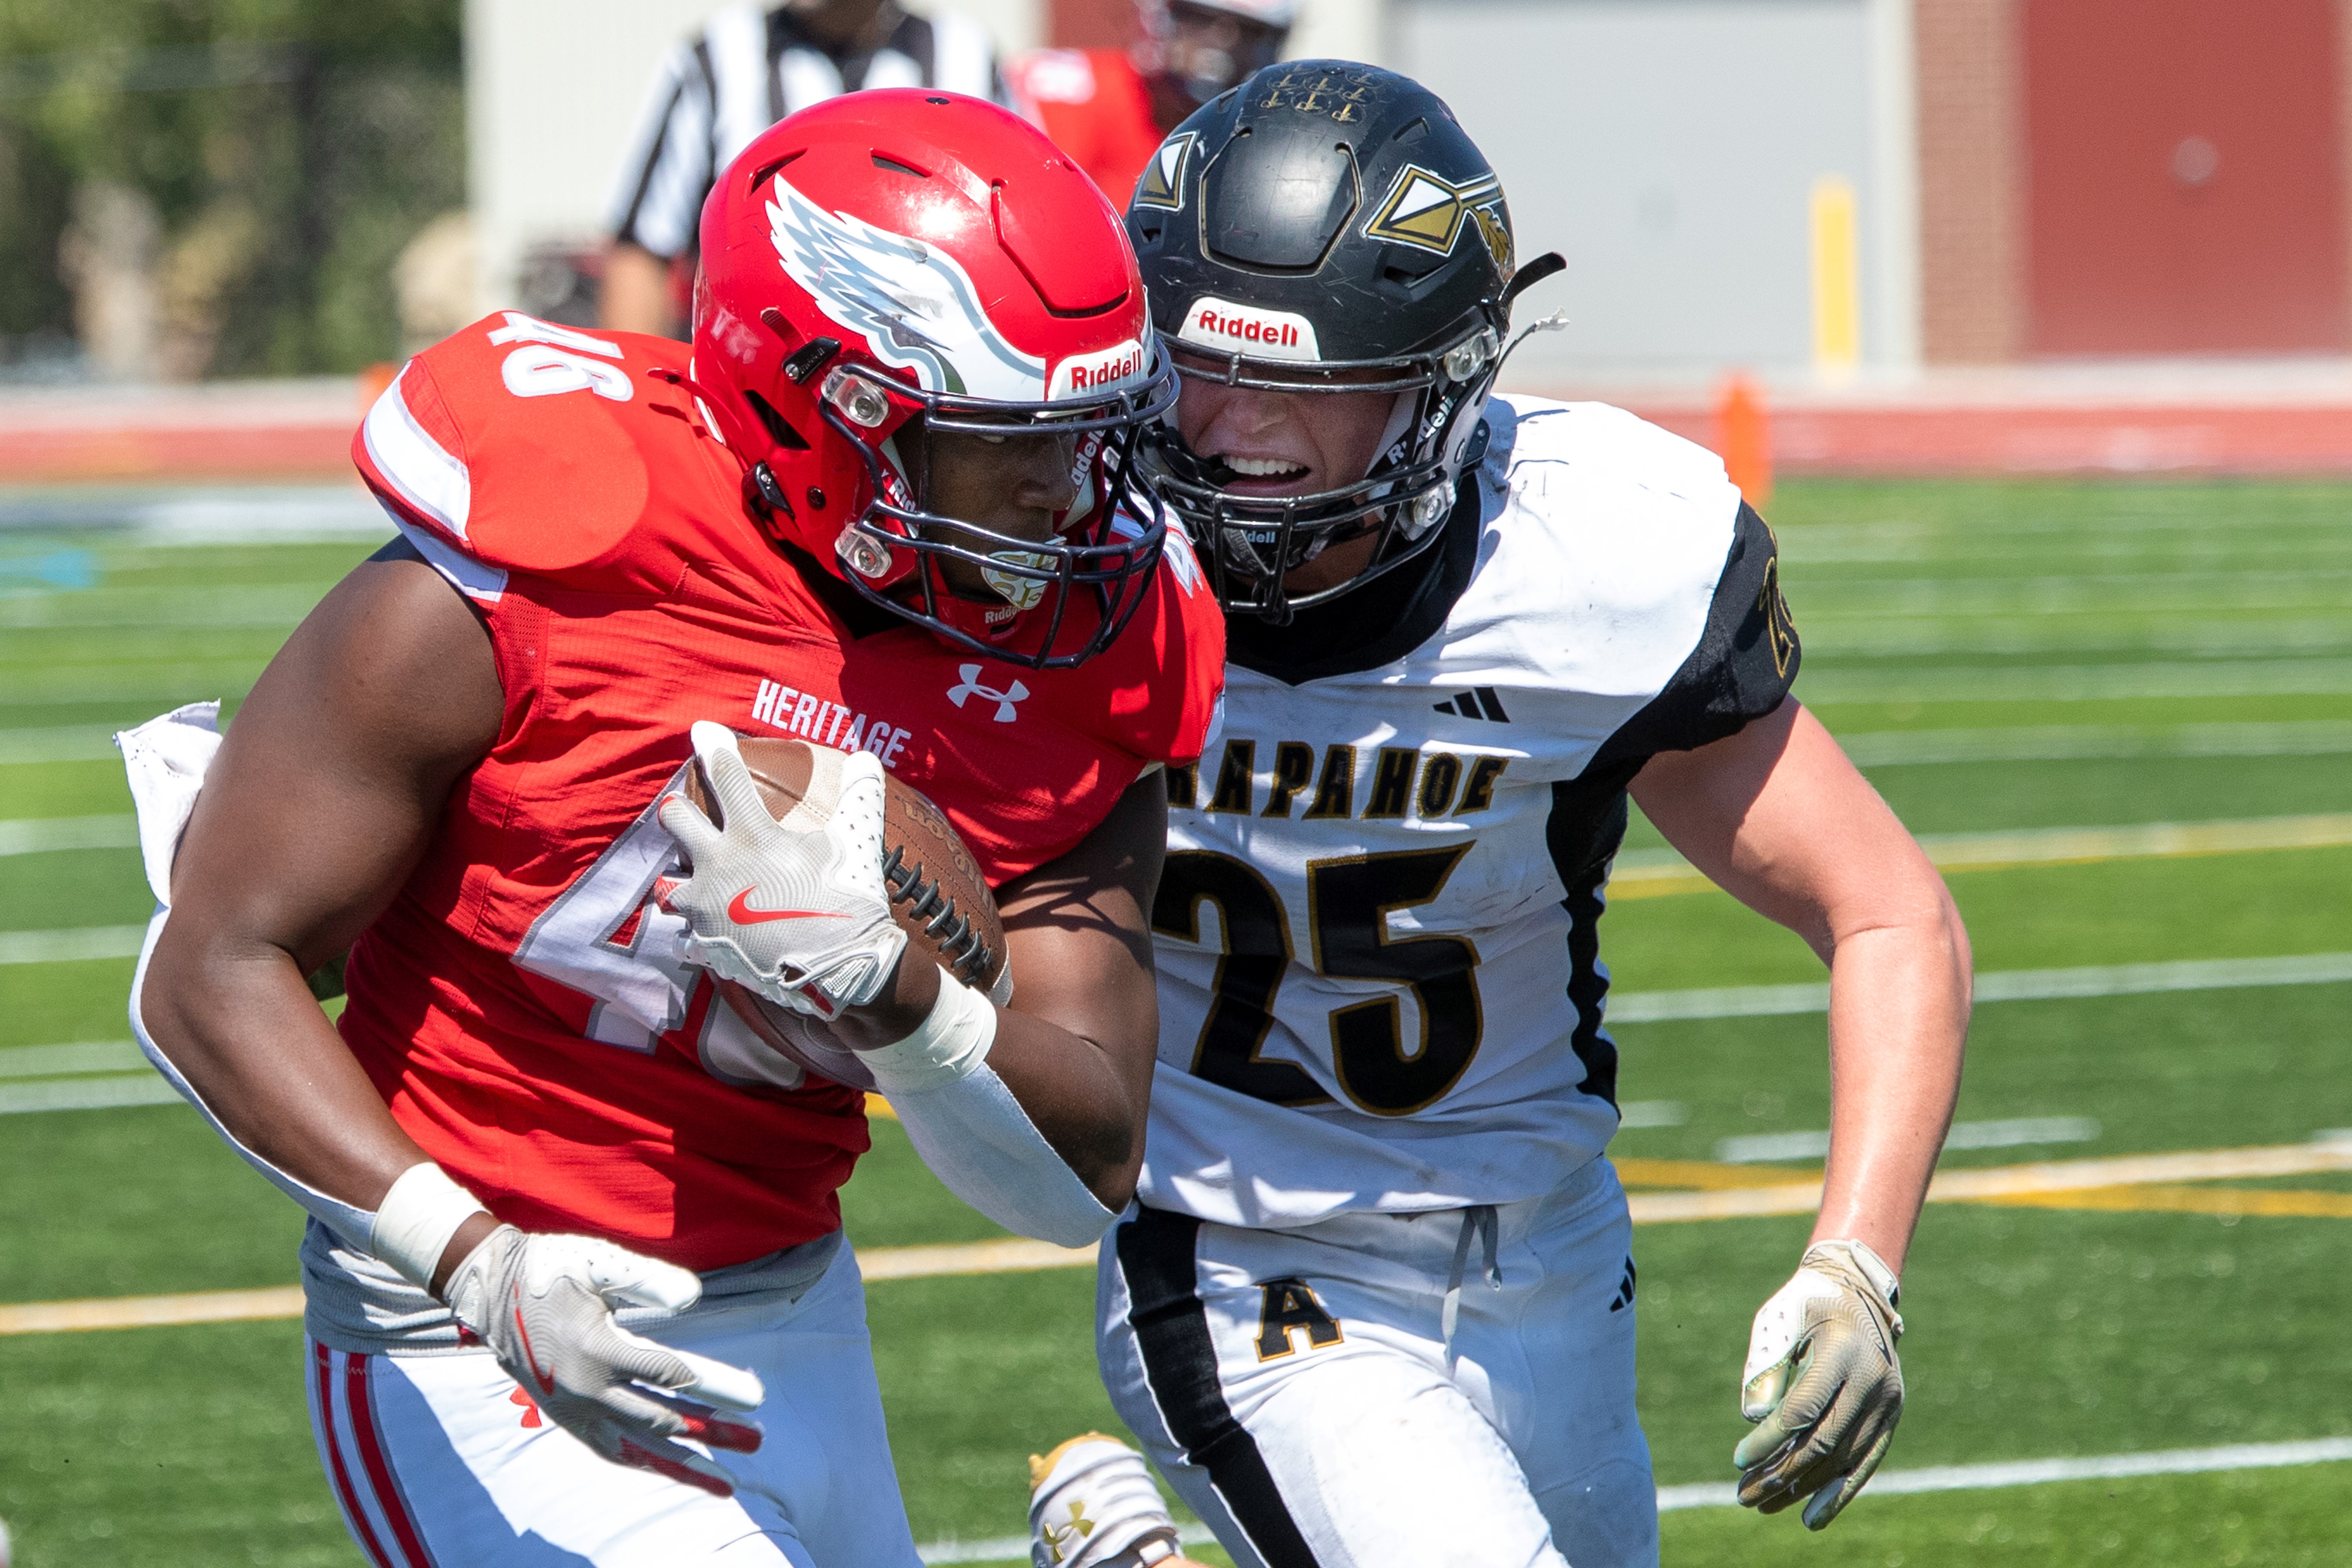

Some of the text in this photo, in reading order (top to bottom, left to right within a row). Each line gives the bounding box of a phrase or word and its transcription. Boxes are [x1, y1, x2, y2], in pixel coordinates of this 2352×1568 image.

[486, 312, 634, 402] 46
[1071, 349, 1141, 390] Riddell
[1199, 310, 1298, 347] Riddell
[751, 679, 912, 769] HERITAGE
[1151, 839, 1485, 1118] 25
[1253, 1277, 1345, 1363] A
